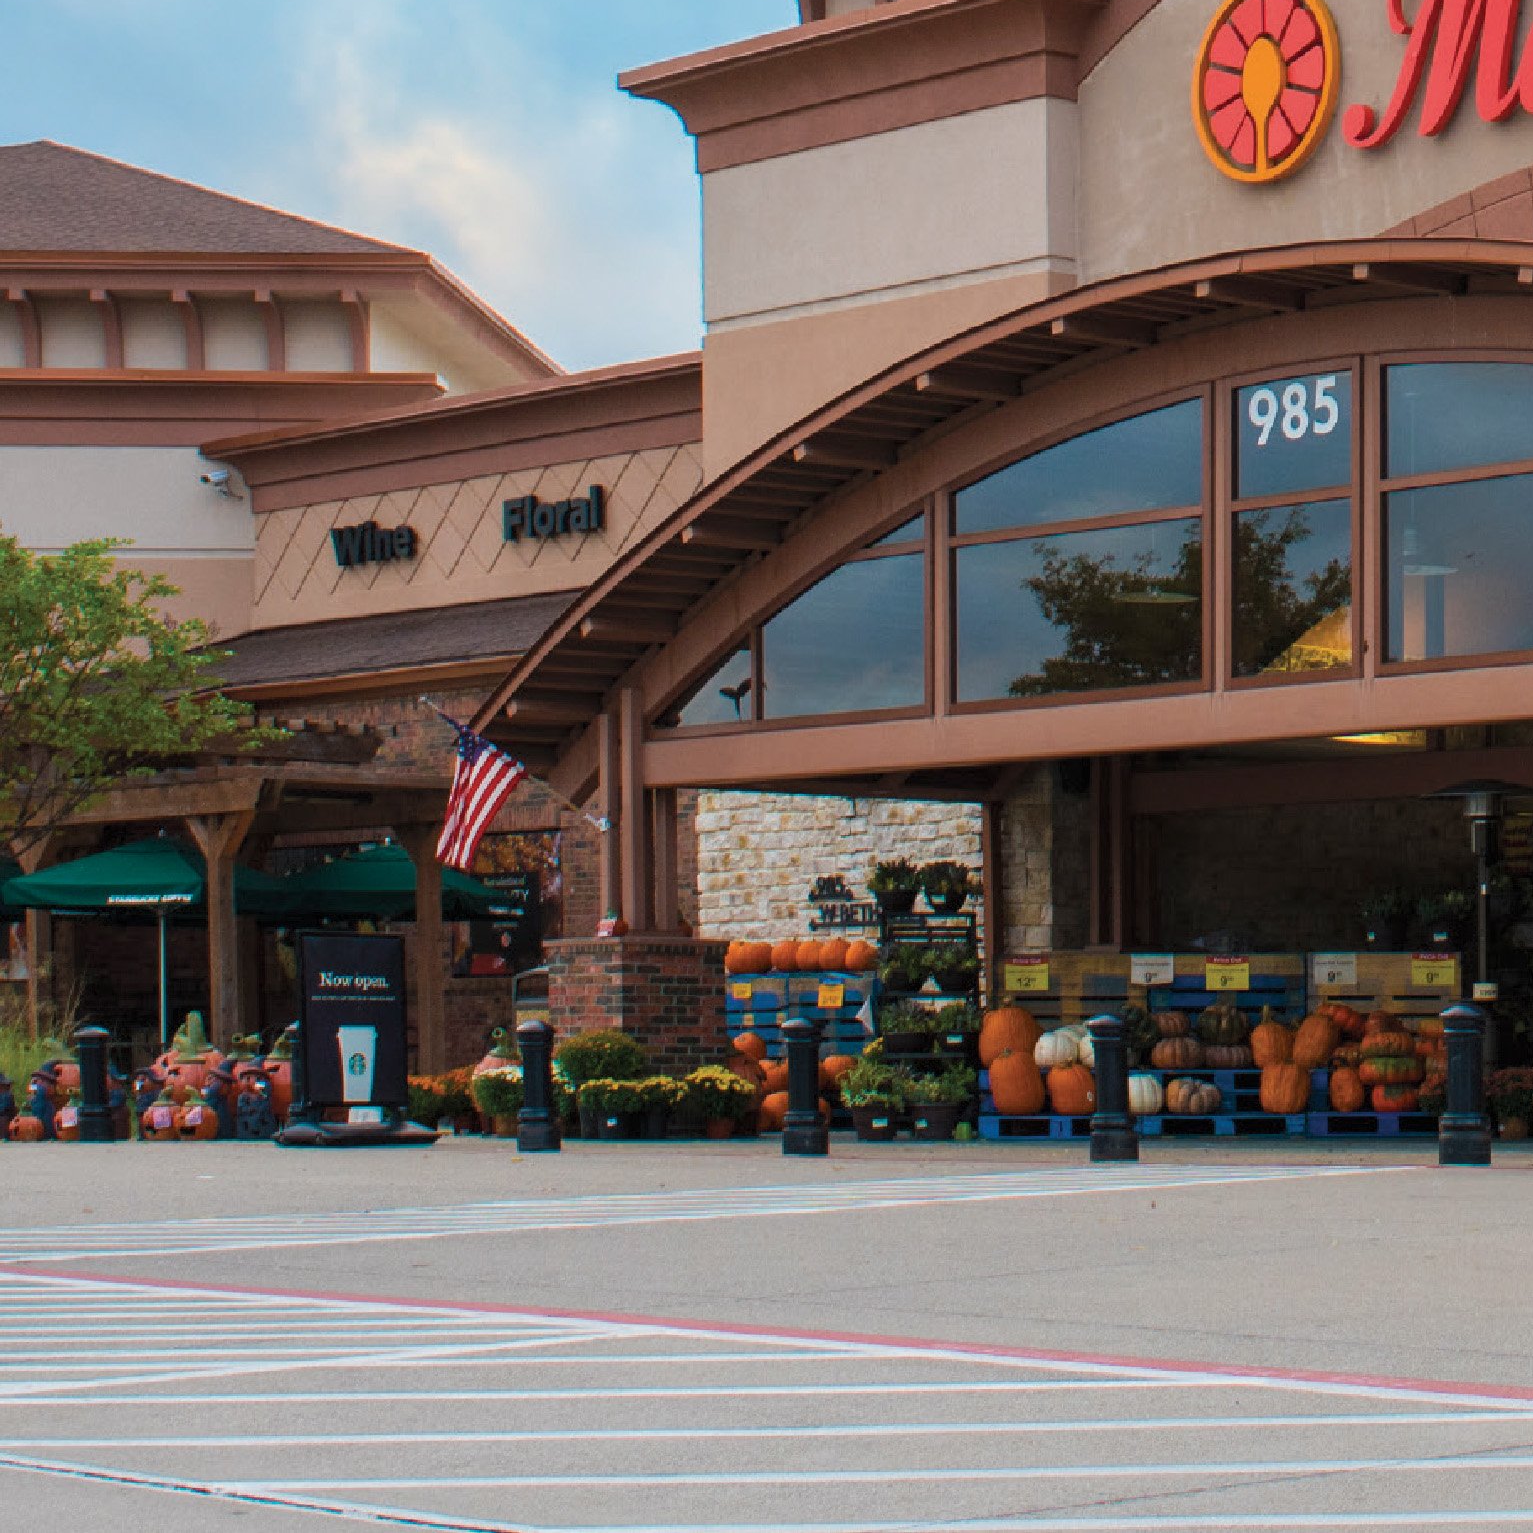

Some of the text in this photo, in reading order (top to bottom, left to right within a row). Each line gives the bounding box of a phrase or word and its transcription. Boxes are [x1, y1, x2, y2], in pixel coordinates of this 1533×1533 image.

[1249, 374, 1340, 446] 985
[502, 484, 605, 542] Floral
[330, 520, 418, 567] Wine
[319, 971, 390, 991] Now open.
